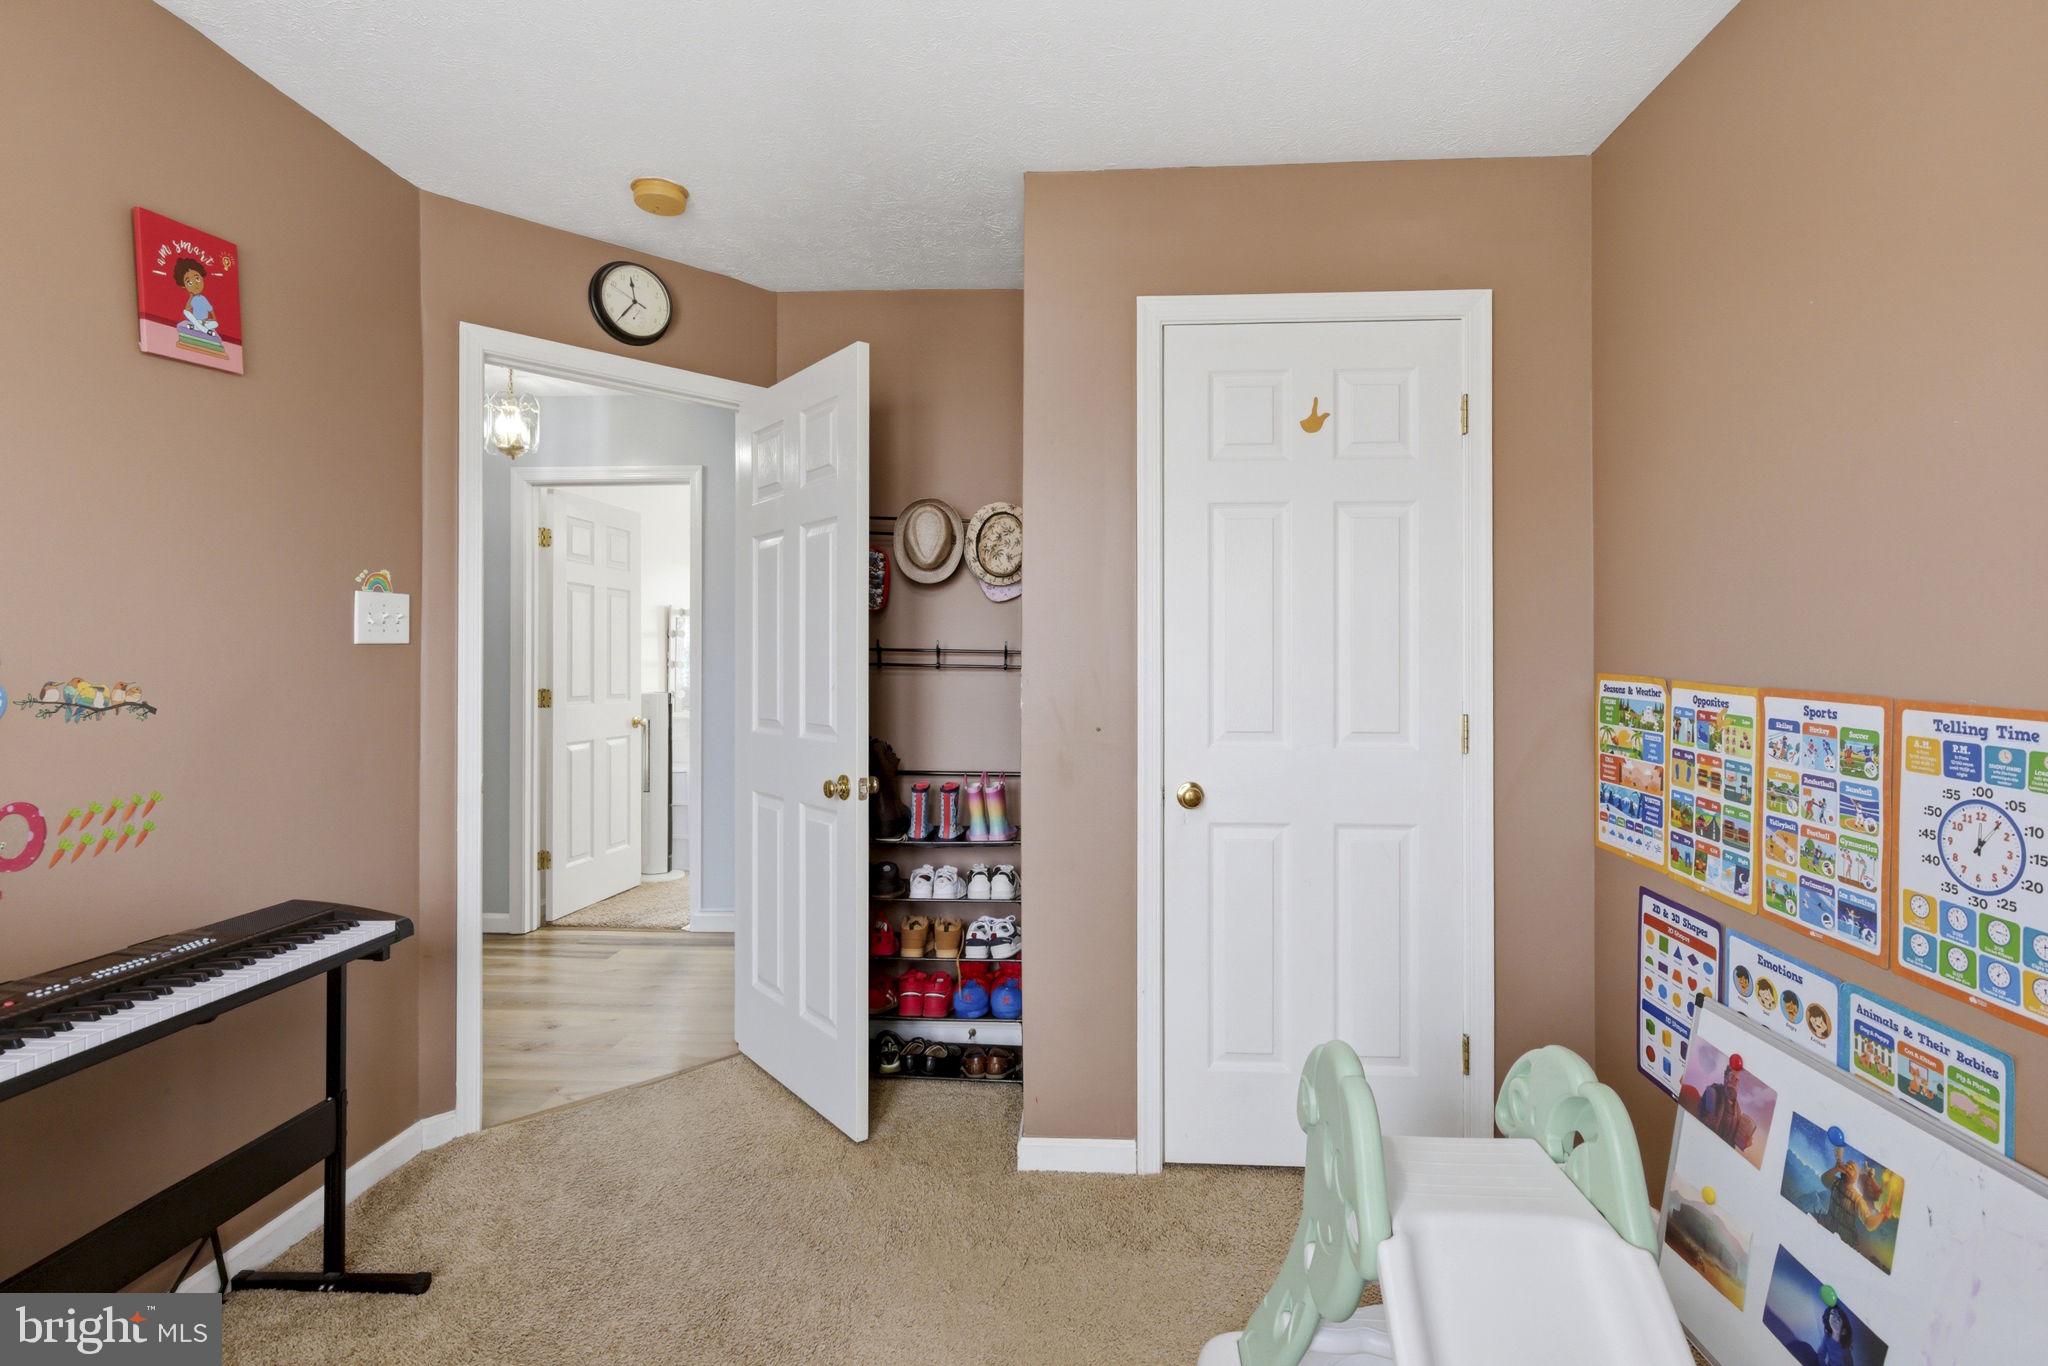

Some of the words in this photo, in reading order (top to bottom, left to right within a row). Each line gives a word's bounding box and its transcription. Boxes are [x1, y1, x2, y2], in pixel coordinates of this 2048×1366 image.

[156, 243, 172, 267] am
[172, 239, 215, 267] smart
[1603, 683, 1626, 694] Seasons
[1628, 686, 1634, 695] &
[1635, 686, 1662, 698] Weather
[1692, 694, 1730, 708] Opposites
[1803, 705, 1838, 720] Sports
[1809, 726, 1830, 736] Hockey
[1848, 731, 1870, 740] Soccer
[1932, 719, 1989, 741] Telling
[1995, 725, 2040, 743] Time
[1952, 744, 1971, 755] P.M.
[1803, 776, 1835, 789] Basketball
[1845, 785, 1873, 797] Baseball
[1942, 789, 1961, 800] :55
[1972, 786, 1994, 799] :00
[1924, 806, 1942, 818] :50
[2005, 800, 2026, 813] :05
[1962, 814, 1972, 824] 11
[1976, 812, 1987, 822] 12
[1952, 822, 1963, 832] 10
[2024, 826, 2044, 839] :10
[1806, 829, 1830, 840] Football
[1918, 828, 1936, 840] :45
[2004, 832, 2010, 842] 2
[1839, 837, 1878, 853] Gymnastics
[1948, 836, 1953, 846] 9
[1921, 854, 1940, 866] :40
[1952, 852, 1958, 862] 8
[2007, 850, 2013, 860] 3
[2029, 854, 2048, 867] :15
[1961, 865, 1967, 874] 7
[2002, 865, 2008, 874] 4
[1976, 874, 1982, 882] 6
[1992, 873, 1998, 882] 5
[1941, 882, 1958, 895] :35
[2021, 880, 2044, 894] :20
[1968, 896, 1988, 910] :30
[1997, 898, 2018, 913] :25
[1652, 904, 1660, 914] 2D
[1662, 909, 1668, 918] &
[1671, 913, 1680, 924] 3D
[1682, 918, 1708, 938] Shapes
[1757, 954, 1804, 985] Emotions
[1856, 1003, 1899, 1032] Animals
[1904, 1026, 1913, 1039] &
[1917, 1032, 1951, 1057] Their
[1955, 1050, 2000, 1080] Babies
